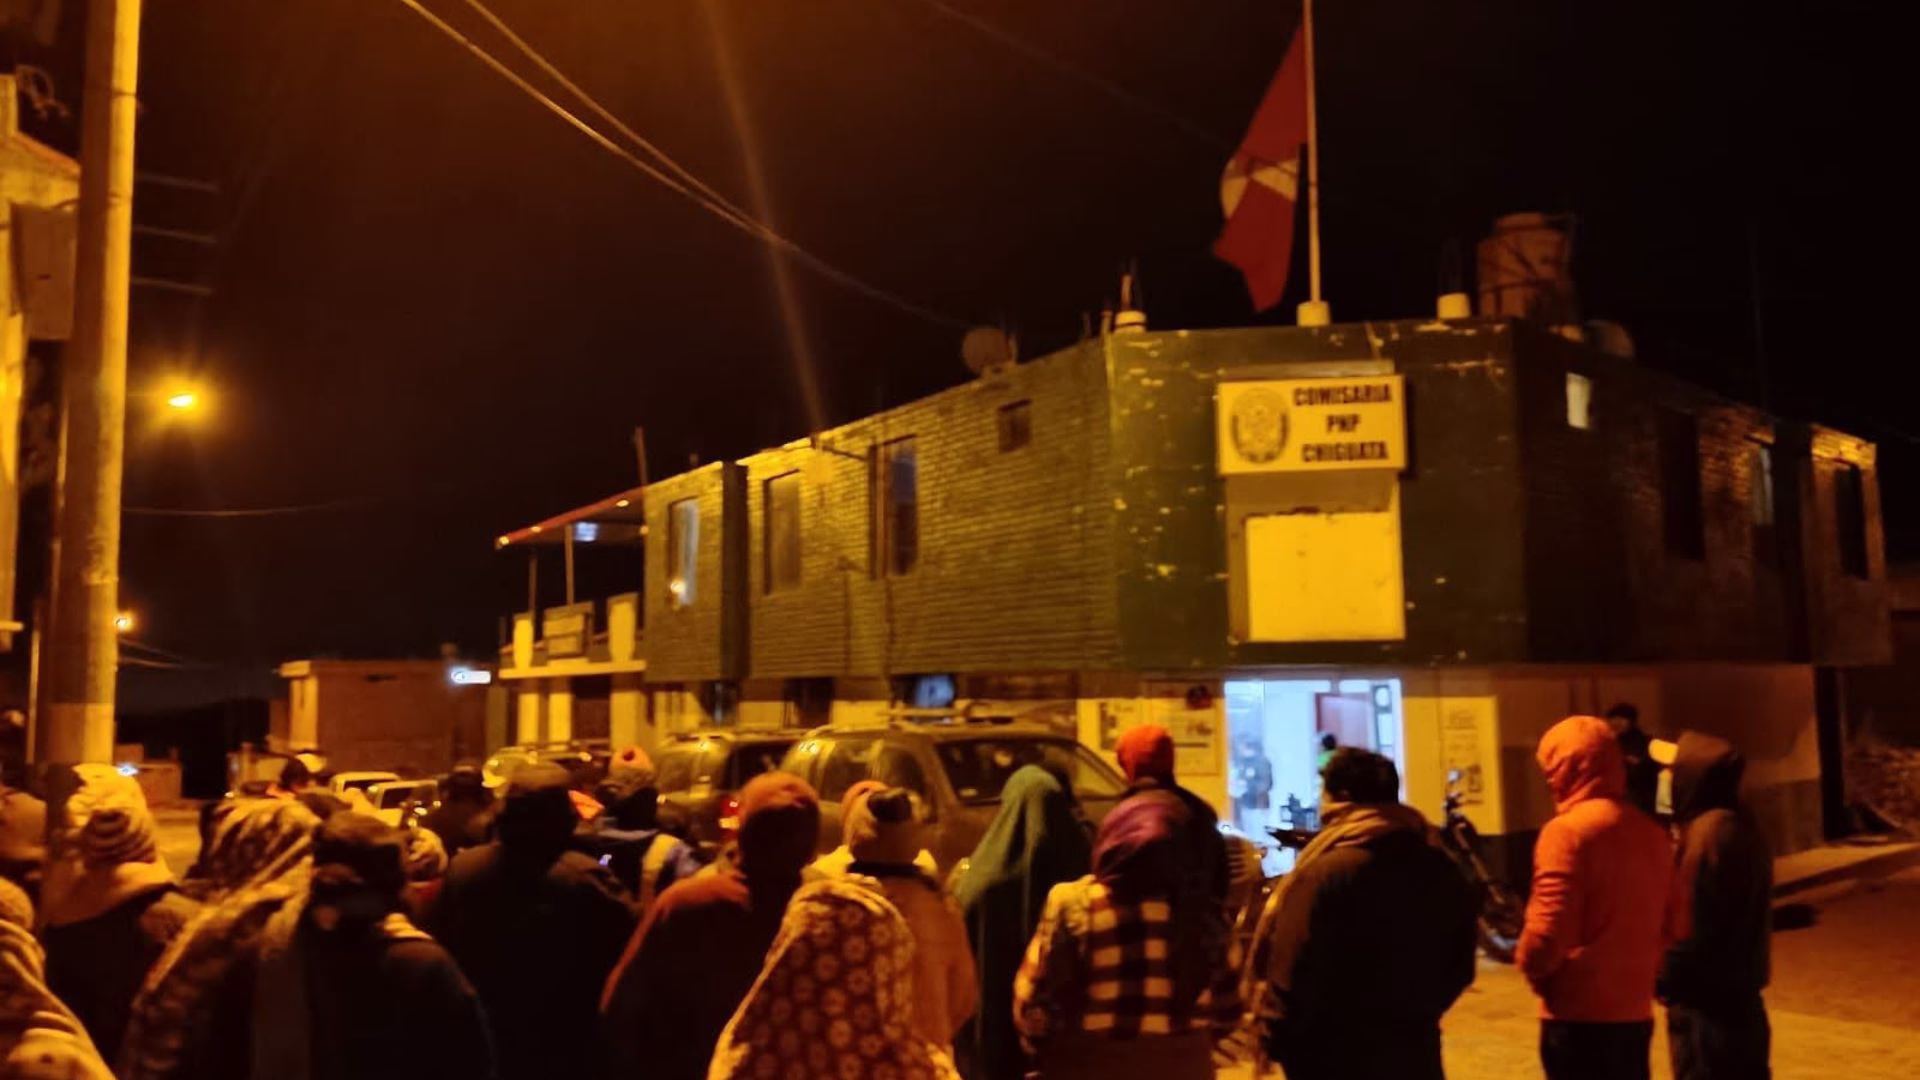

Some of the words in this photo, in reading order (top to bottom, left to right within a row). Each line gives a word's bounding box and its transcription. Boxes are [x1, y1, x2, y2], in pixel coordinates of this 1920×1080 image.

[1294, 385, 1392, 406] COMISARIA
[1326, 414, 1360, 433] PNP
[1302, 441, 1389, 462] CHIGUATA
